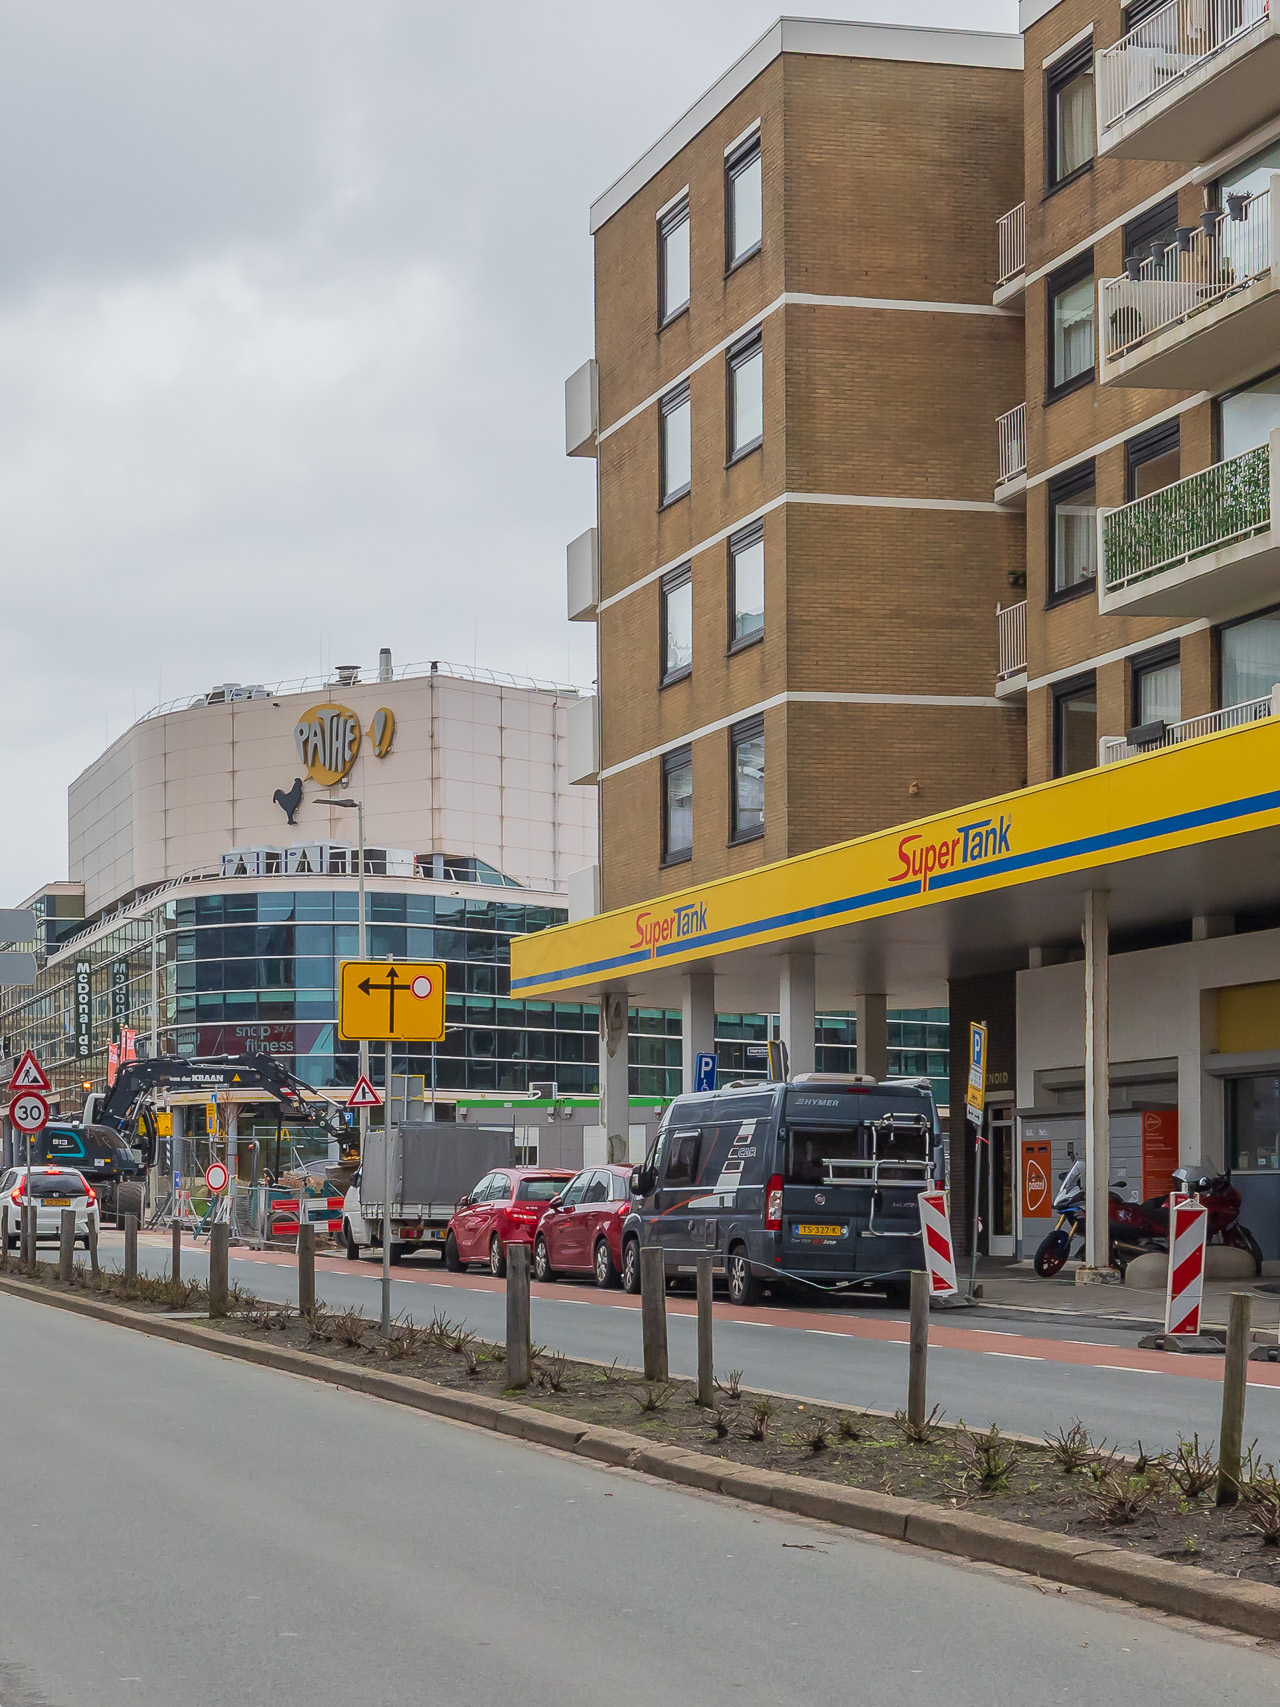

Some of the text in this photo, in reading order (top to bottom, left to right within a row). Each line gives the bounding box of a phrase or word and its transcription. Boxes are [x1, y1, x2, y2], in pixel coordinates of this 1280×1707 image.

[888, 815, 1011, 892] SuperTank
[629, 901, 707, 958] SuperTank
[76, 962, 91, 1055] McDonalds
[974, 1033, 980, 1061] P
[191, 1074, 223, 1082] KRAAN
[701, 1057, 713, 1078] P
[985, 1072, 1008, 1084] ENDID
[18, 1105, 41, 1121] 30
[804, 1099, 839, 1107] HYMER
